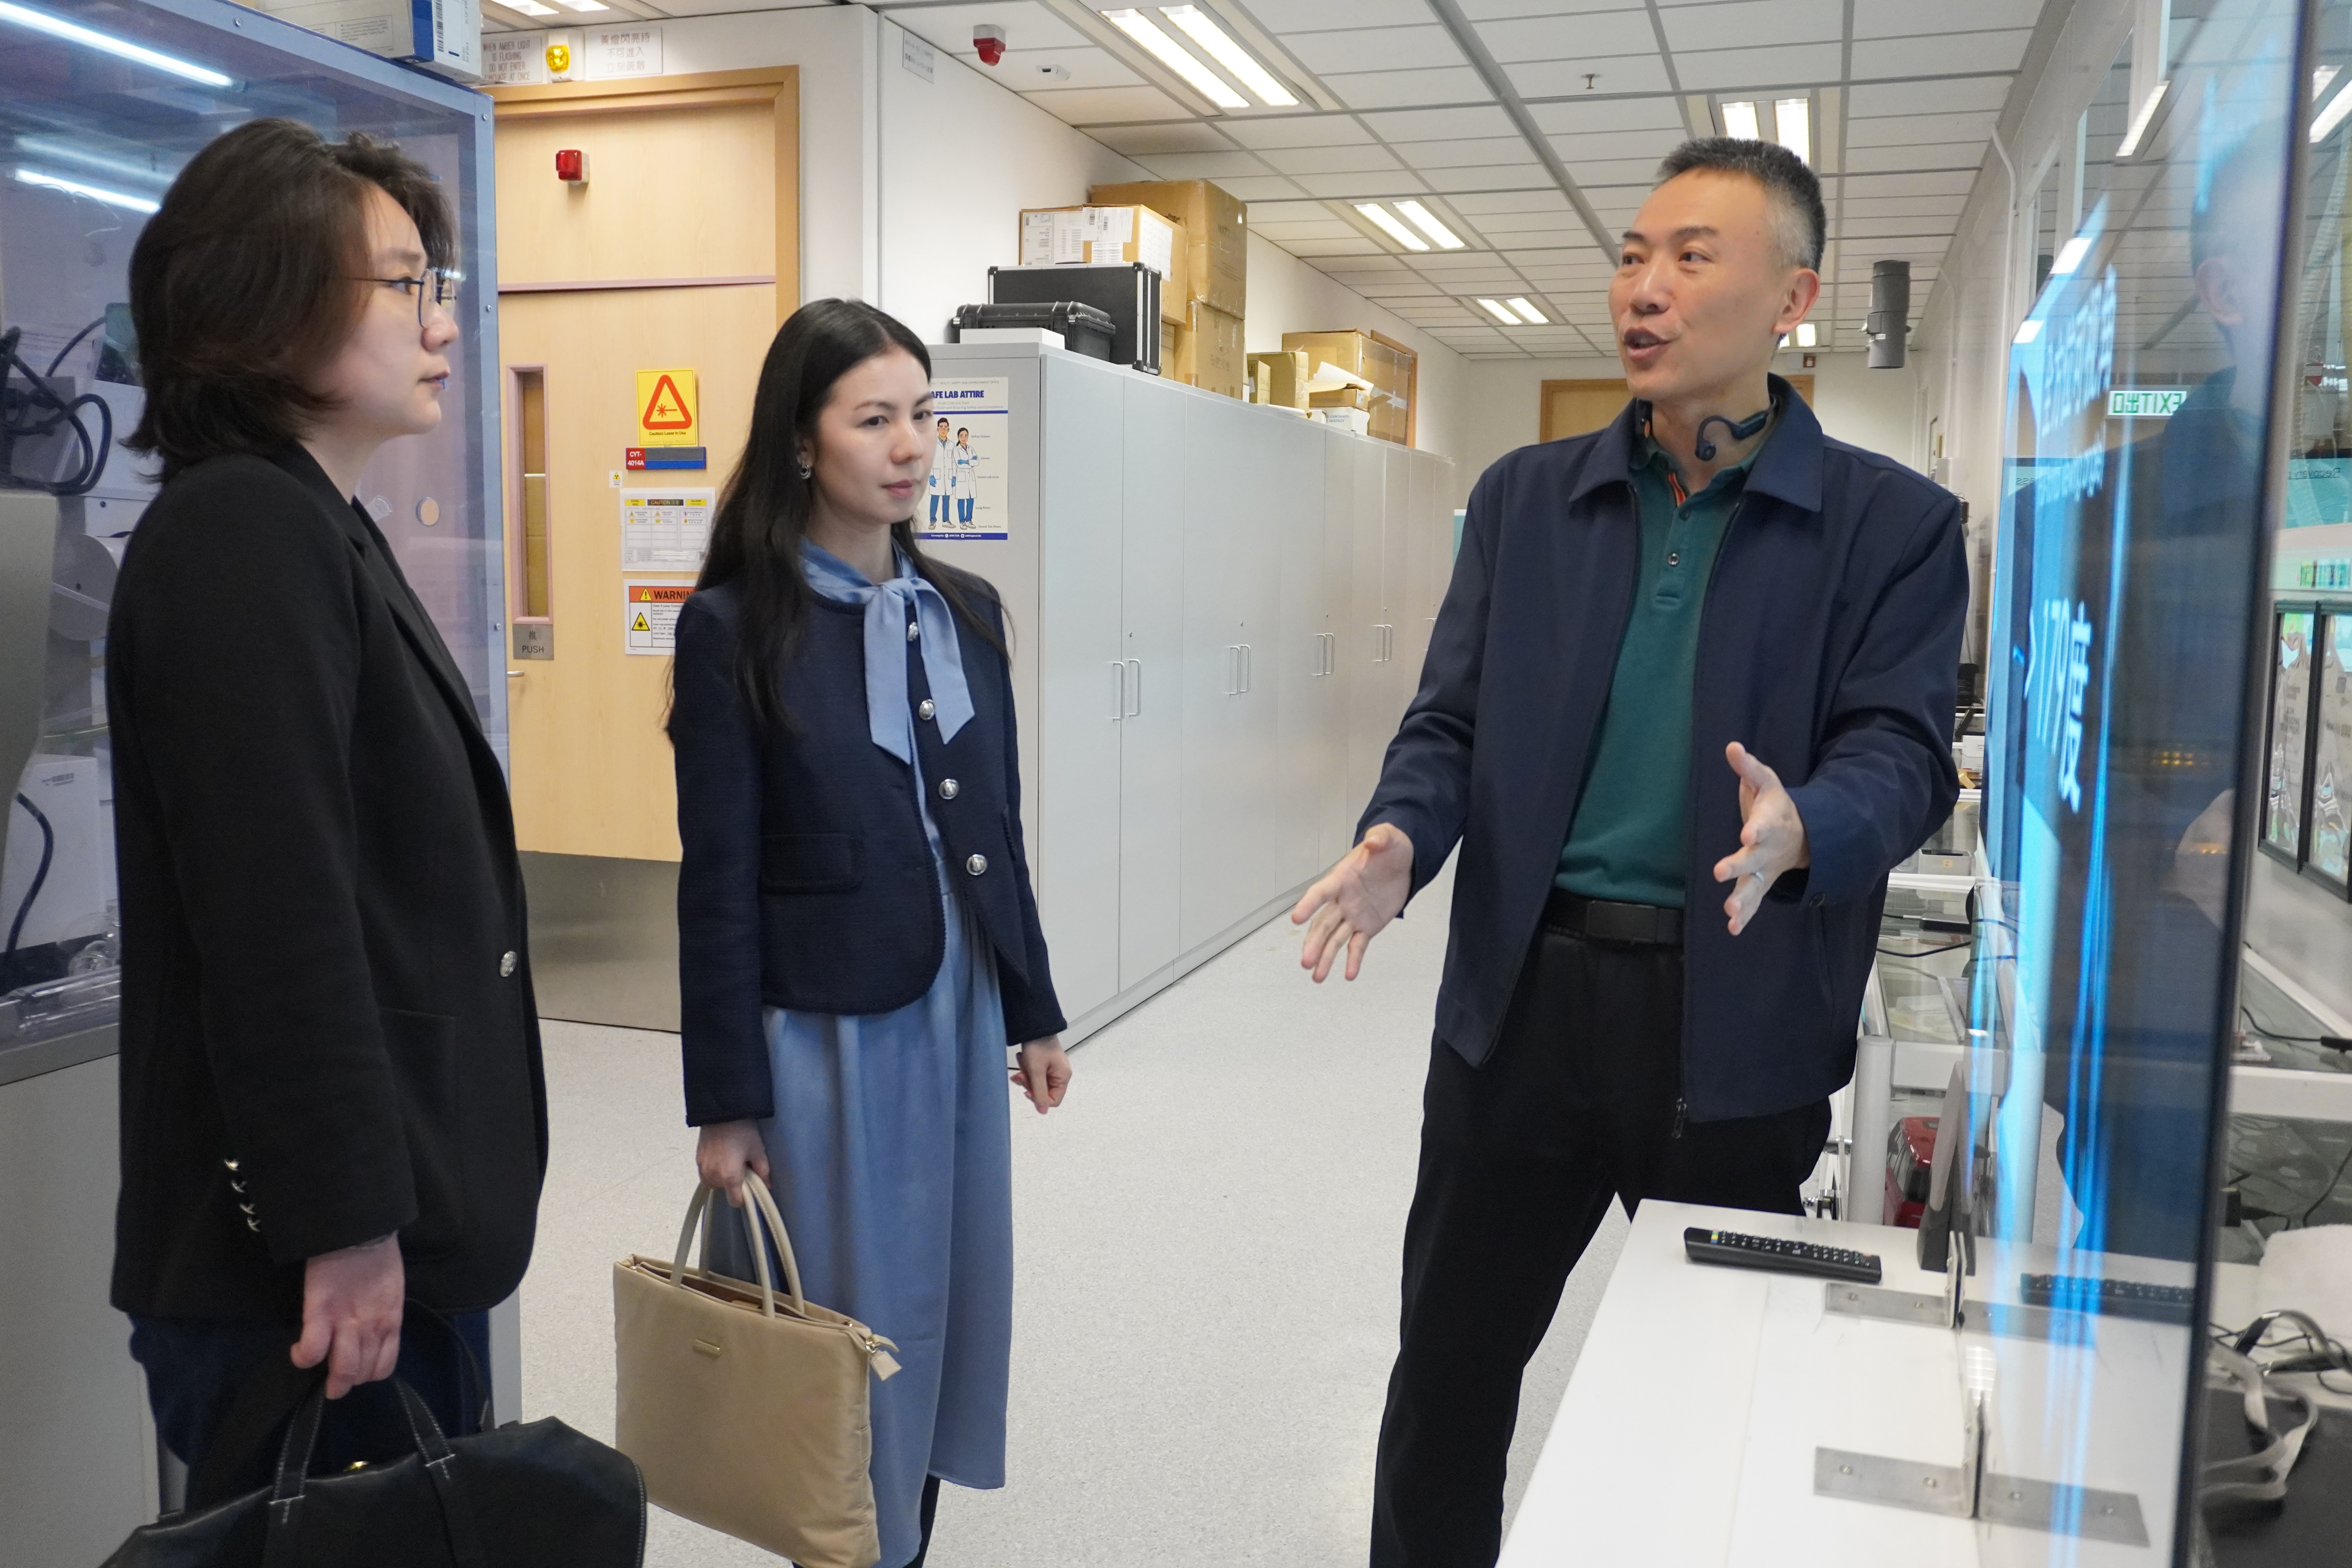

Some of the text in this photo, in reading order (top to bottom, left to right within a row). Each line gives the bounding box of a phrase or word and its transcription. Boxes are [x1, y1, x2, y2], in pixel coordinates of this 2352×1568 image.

[483, 40, 530, 51] WHEN AMBER LIGHT
[499, 51, 522, 61] FLASHING
[607, 47, 644, 58] 不可進入
[489, 61, 525, 72] DO NOT ENTER
[517, 72, 530, 80] ONCE
[653, 591, 693, 599] WARNIN
[522, 645, 544, 653] PUSH
